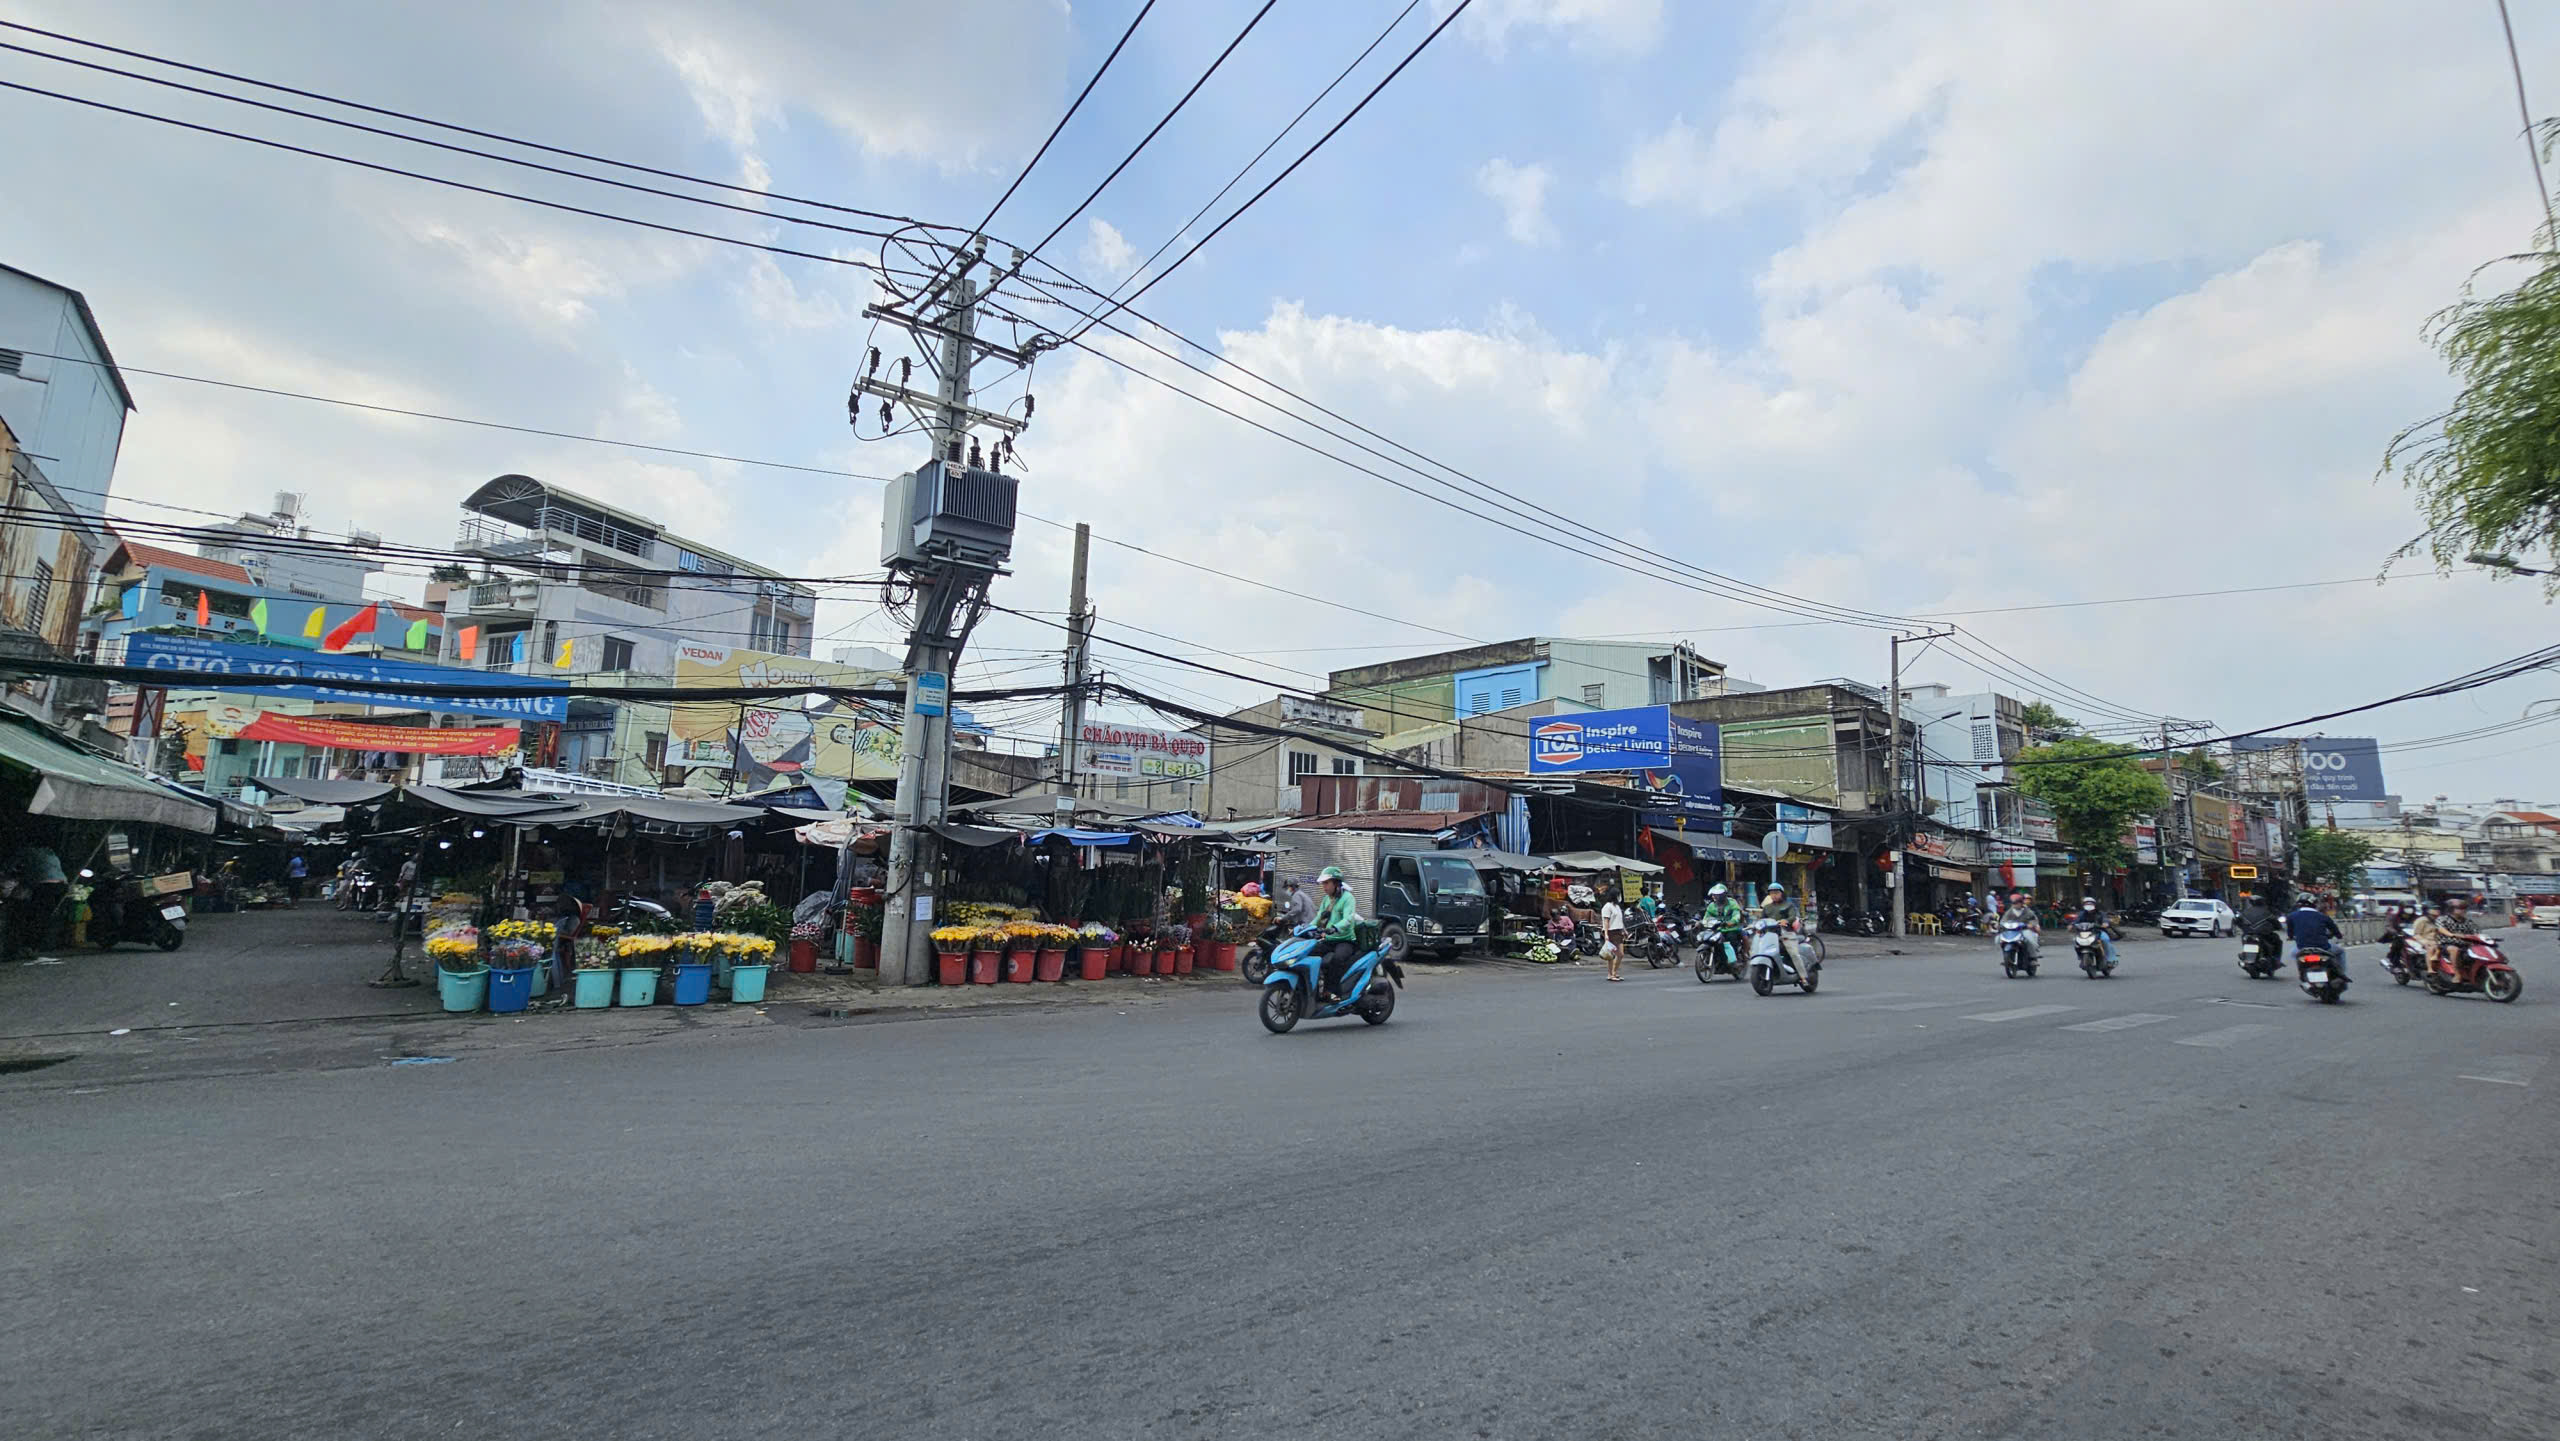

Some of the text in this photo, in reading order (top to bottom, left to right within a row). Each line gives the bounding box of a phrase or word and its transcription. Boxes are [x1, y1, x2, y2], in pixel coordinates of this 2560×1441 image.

[682, 647, 723, 661] VEDAN
[1586, 724, 1638, 739] Inspire
[1677, 725, 1702, 740] Inspire
[1084, 724, 1205, 758] CHÁO VỊT BÀ QUẸO
[1539, 734, 1579, 753] TOA
[1624, 740, 1662, 754] Living
